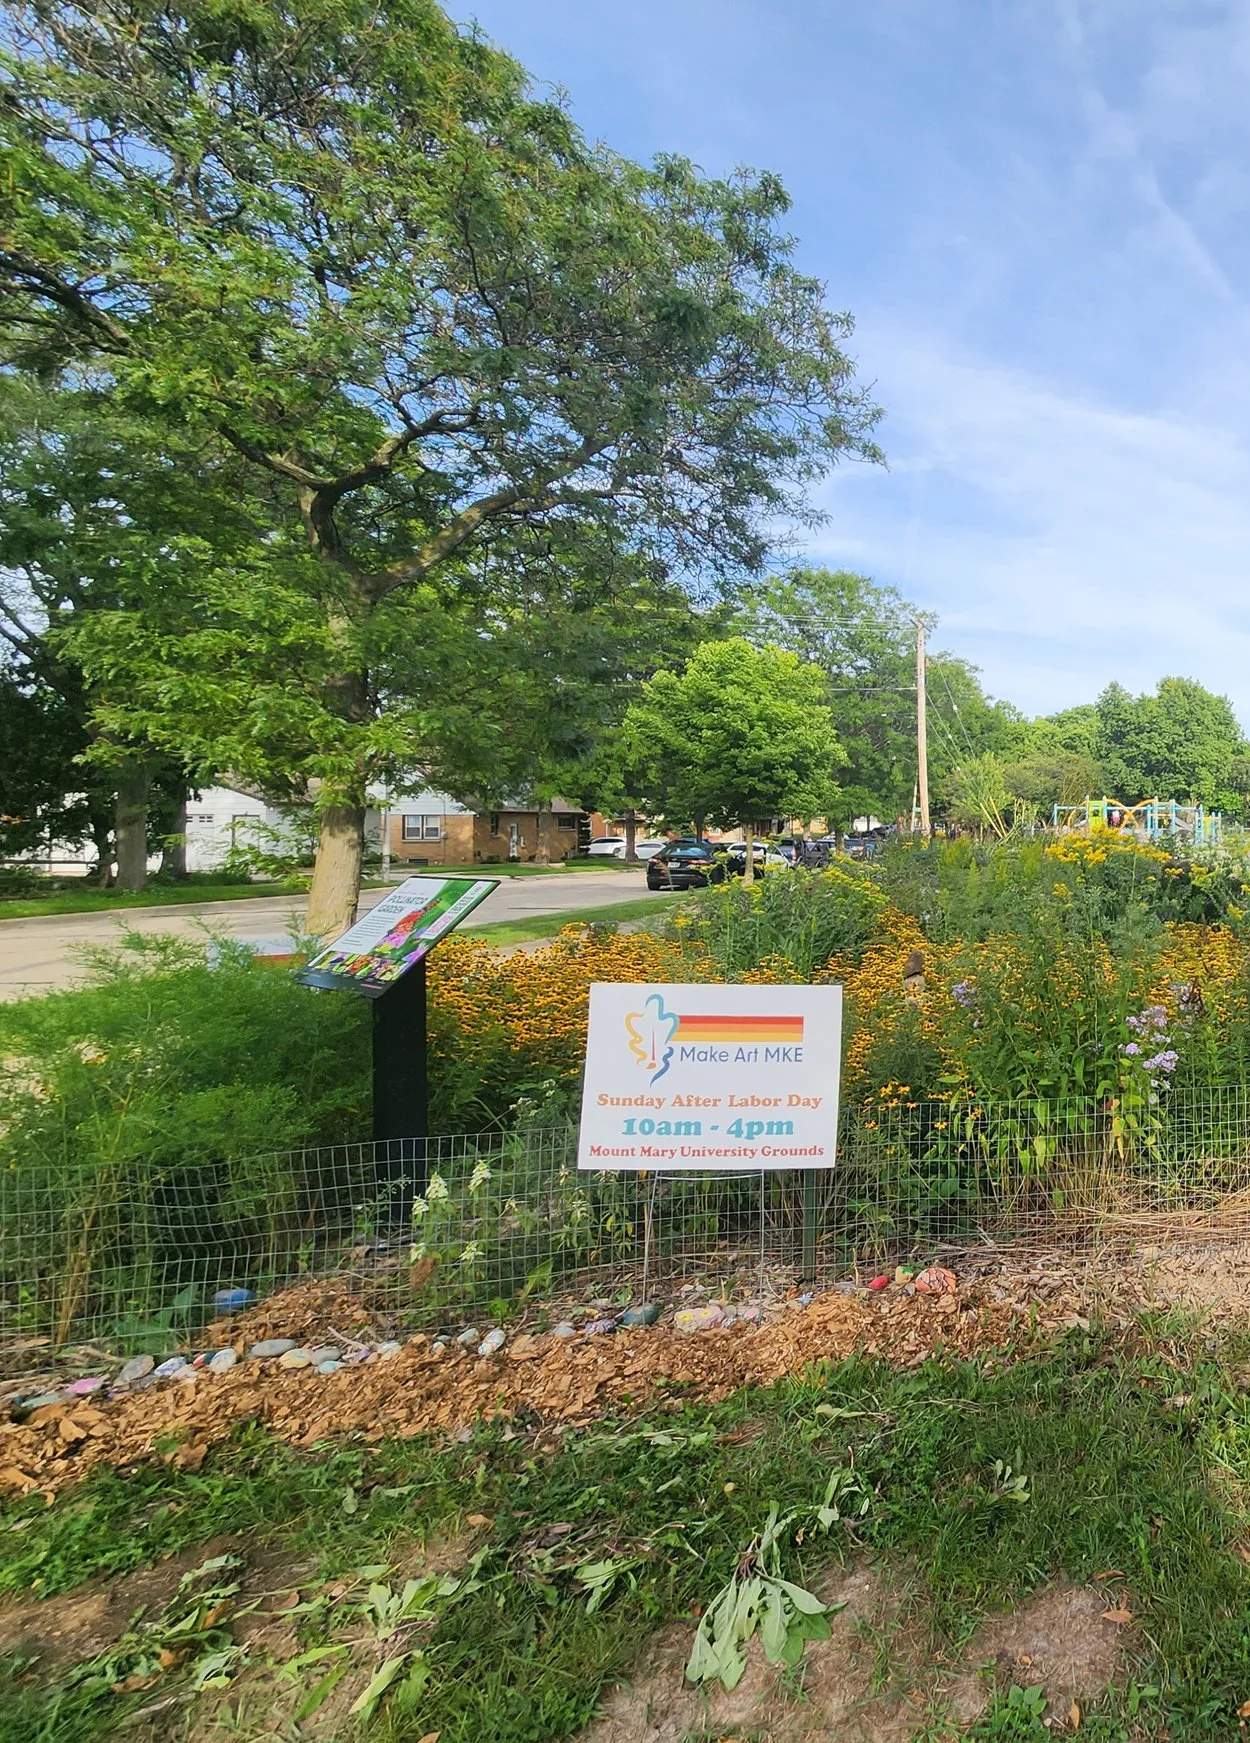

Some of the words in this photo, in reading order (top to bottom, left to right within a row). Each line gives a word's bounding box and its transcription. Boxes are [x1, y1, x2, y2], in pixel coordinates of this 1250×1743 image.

[388, 895, 428, 904] POLLINATOR
[378, 904, 405, 913] GARDEN
[680, 1045, 729, 1063] Make
[734, 1046, 759, 1063] Art
[764, 1047, 803, 1063] MKE
[597, 1093, 666, 1110] Sunday
[671, 1094, 721, 1108] After
[728, 1094, 782, 1108] Labor
[787, 1094, 822, 1110] Day
[622, 1118, 702, 1136] 10am
[727, 1118, 794, 1140] 4pm
[589, 1145, 636, 1157] Mount
[640, 1146, 677, 1159] Mary
[680, 1145, 758, 1159] University
[760, 1145, 824, 1157] Grounds
